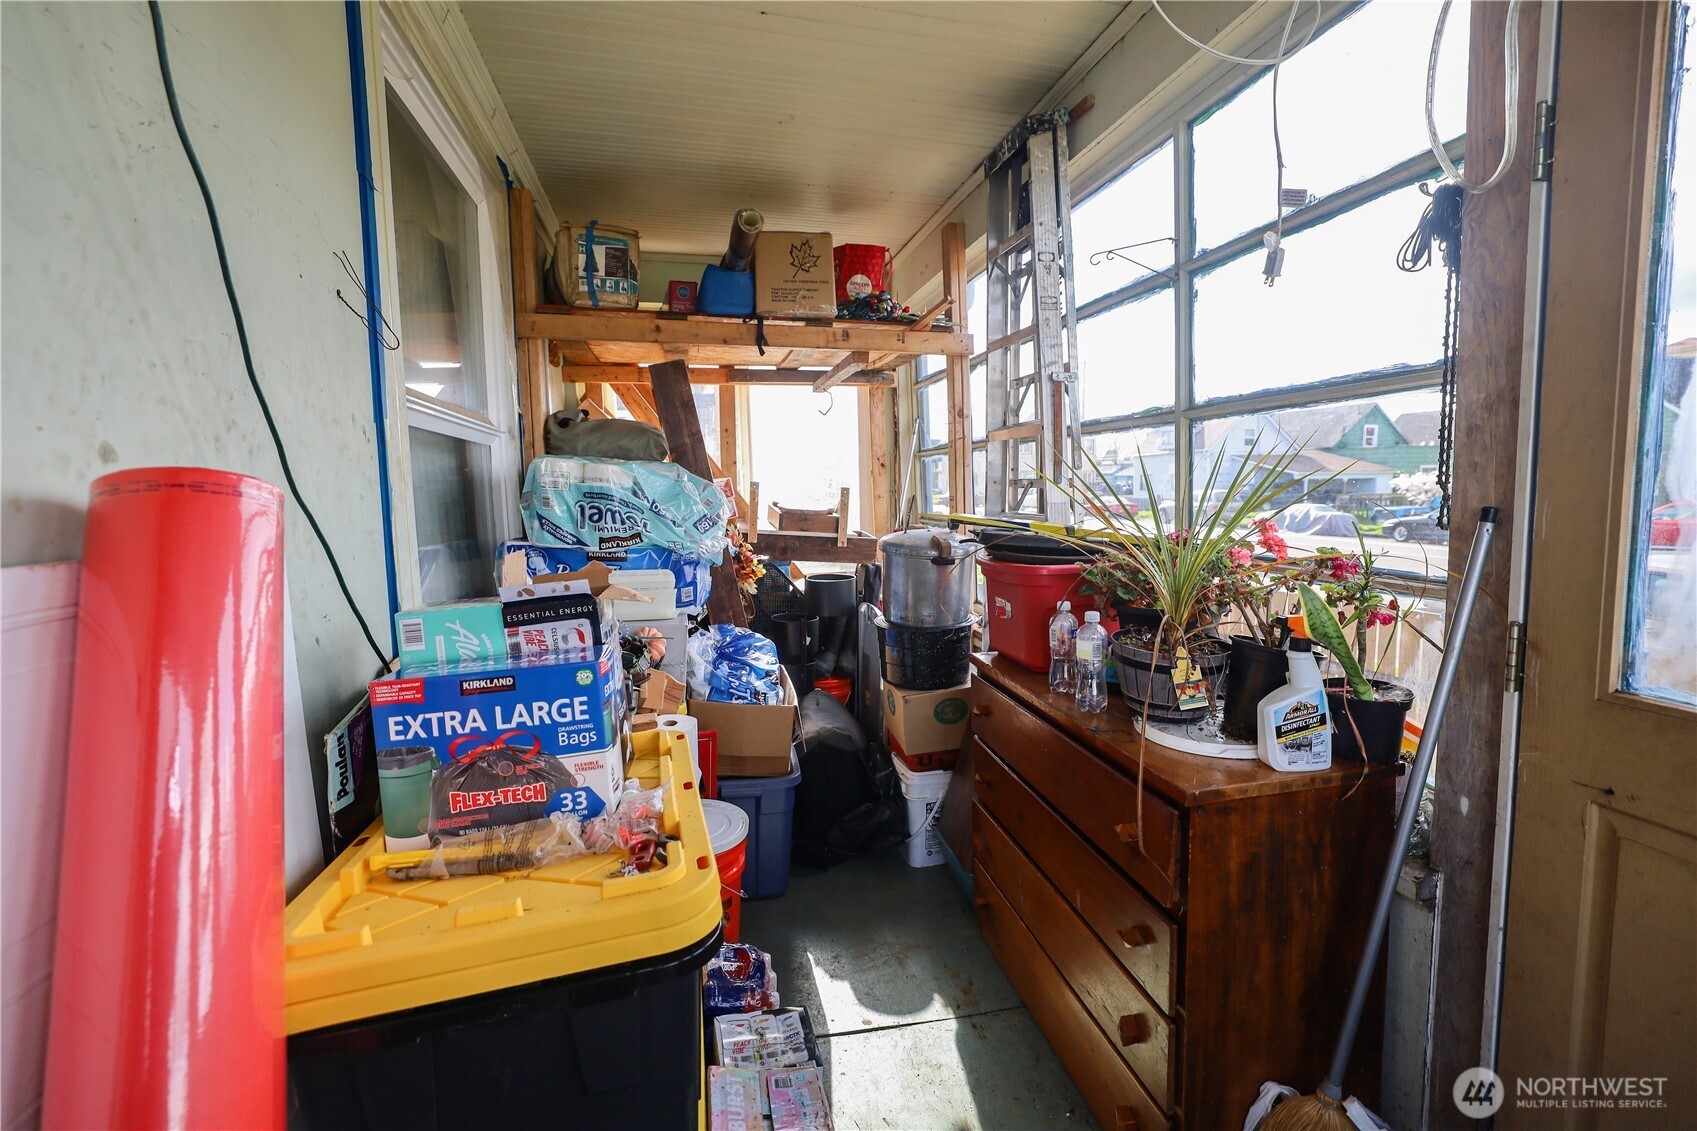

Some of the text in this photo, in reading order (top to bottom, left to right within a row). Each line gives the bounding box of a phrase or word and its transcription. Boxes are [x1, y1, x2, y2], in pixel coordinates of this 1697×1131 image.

[542, 519, 577, 542] WRAPPED ROLLS
[697, 519, 713, 533] 160
[543, 525, 573, 544] INDIVIDUALLY
[600, 537, 641, 549] KIRKLAND
[506, 605, 594, 622] ESSENTIAL ENERGY
[480, 633, 494, 655] VARIETY
[522, 629, 536, 646] VIBE
[551, 627, 560, 651] CELSIUS
[462, 677, 514, 690] KIRKLAND
[576, 672, 593, 680] 20%
[388, 708, 487, 741] EXTRA
[495, 696, 590, 730] LARGE
[1286, 709, 1308, 720] ARMOR
[558, 723, 594, 732] DRAWSTRING
[1281, 716, 1321, 732] DISINFECTANT
[558, 731, 597, 746] Bags
[335, 733, 350, 801] Poulan
[574, 760, 600, 768] FLEXIBLE
[574, 764, 604, 772] STRENGTH
[449, 781, 547, 814] FLEX-TECH
[560, 791, 588, 812] 33
[732, 1047, 745, 1055] VIBE
[734, 1040, 751, 1048] PEACH
